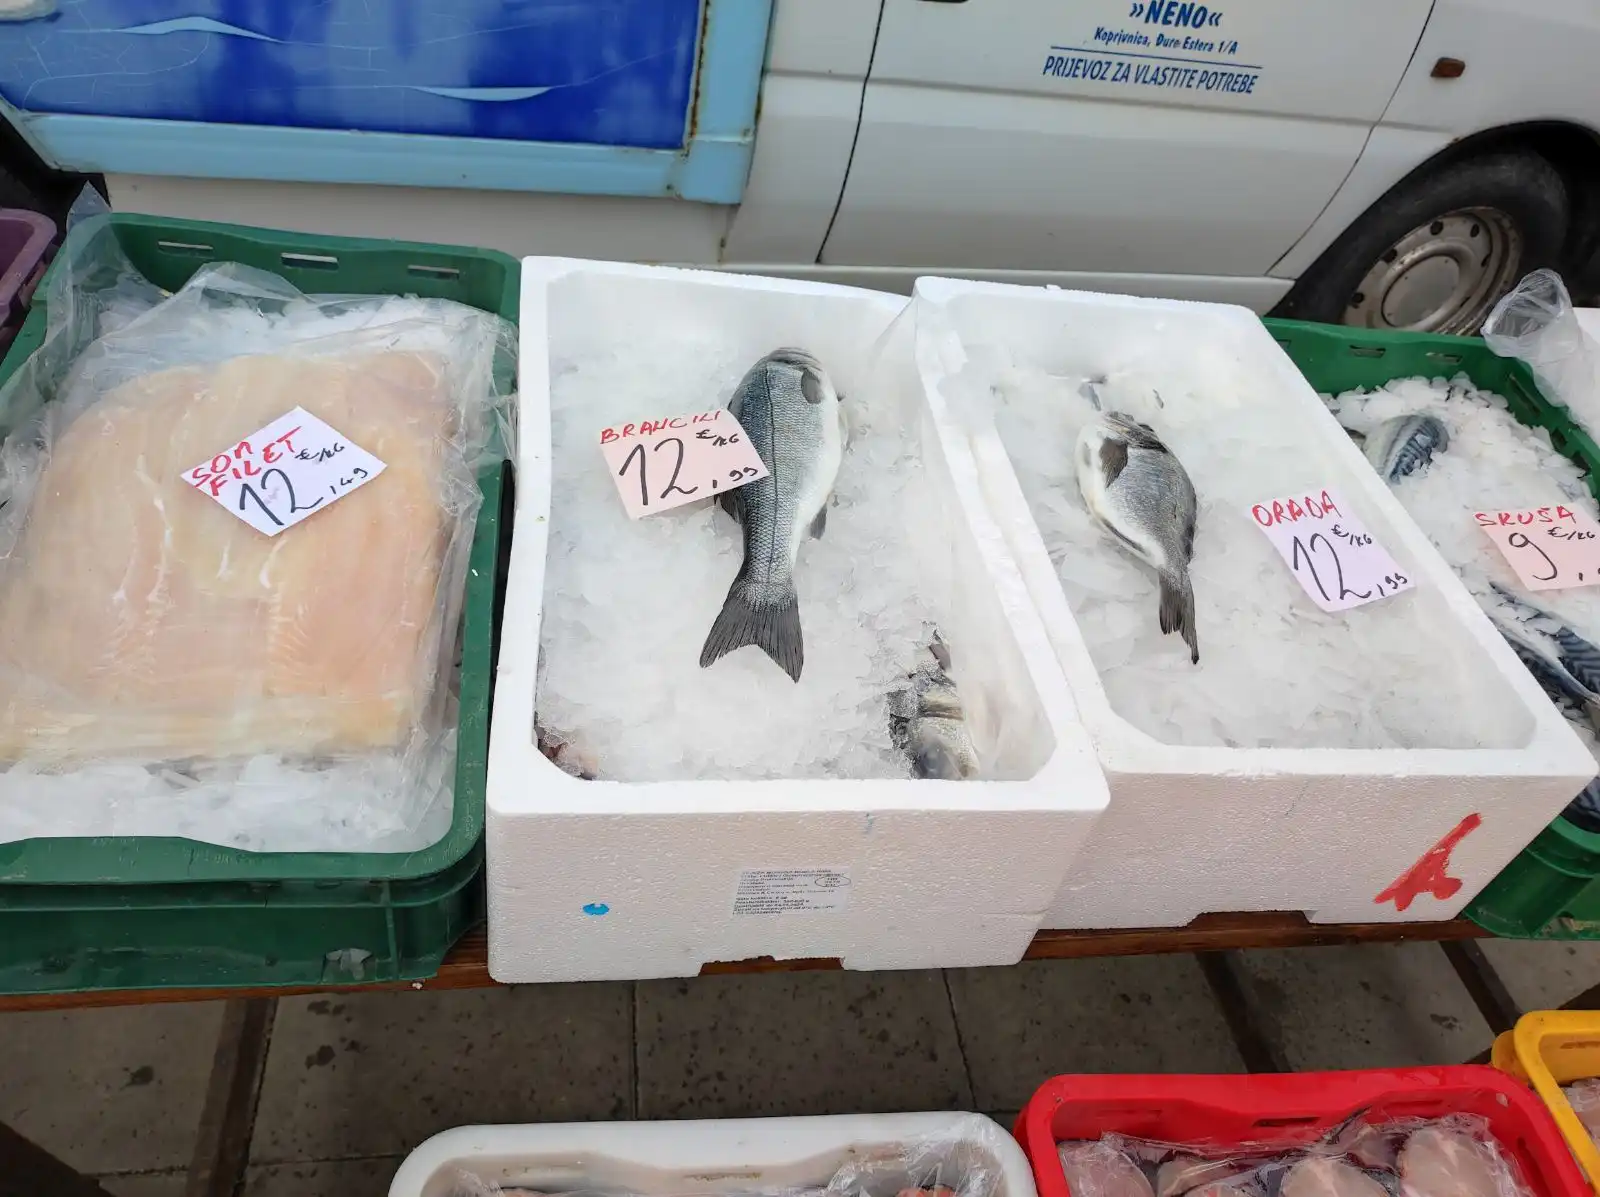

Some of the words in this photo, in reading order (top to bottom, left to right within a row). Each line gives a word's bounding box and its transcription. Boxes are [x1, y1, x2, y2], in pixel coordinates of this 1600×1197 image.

[1094, 27, 1151, 47] Koprivnica,
[1182, 36, 1214, 52] Estera
[1218, 40, 1238, 55] 1/A
[1043, 55, 1110, 81] PRIJEVOZ
[1111, 63, 1131, 82] ZA
[1134, 64, 1198, 89] VLASTITE
[1196, 72, 1259, 94] POTREBE
[209, 426, 302, 497] FILET
[1252, 490, 1342, 527] ORADA
